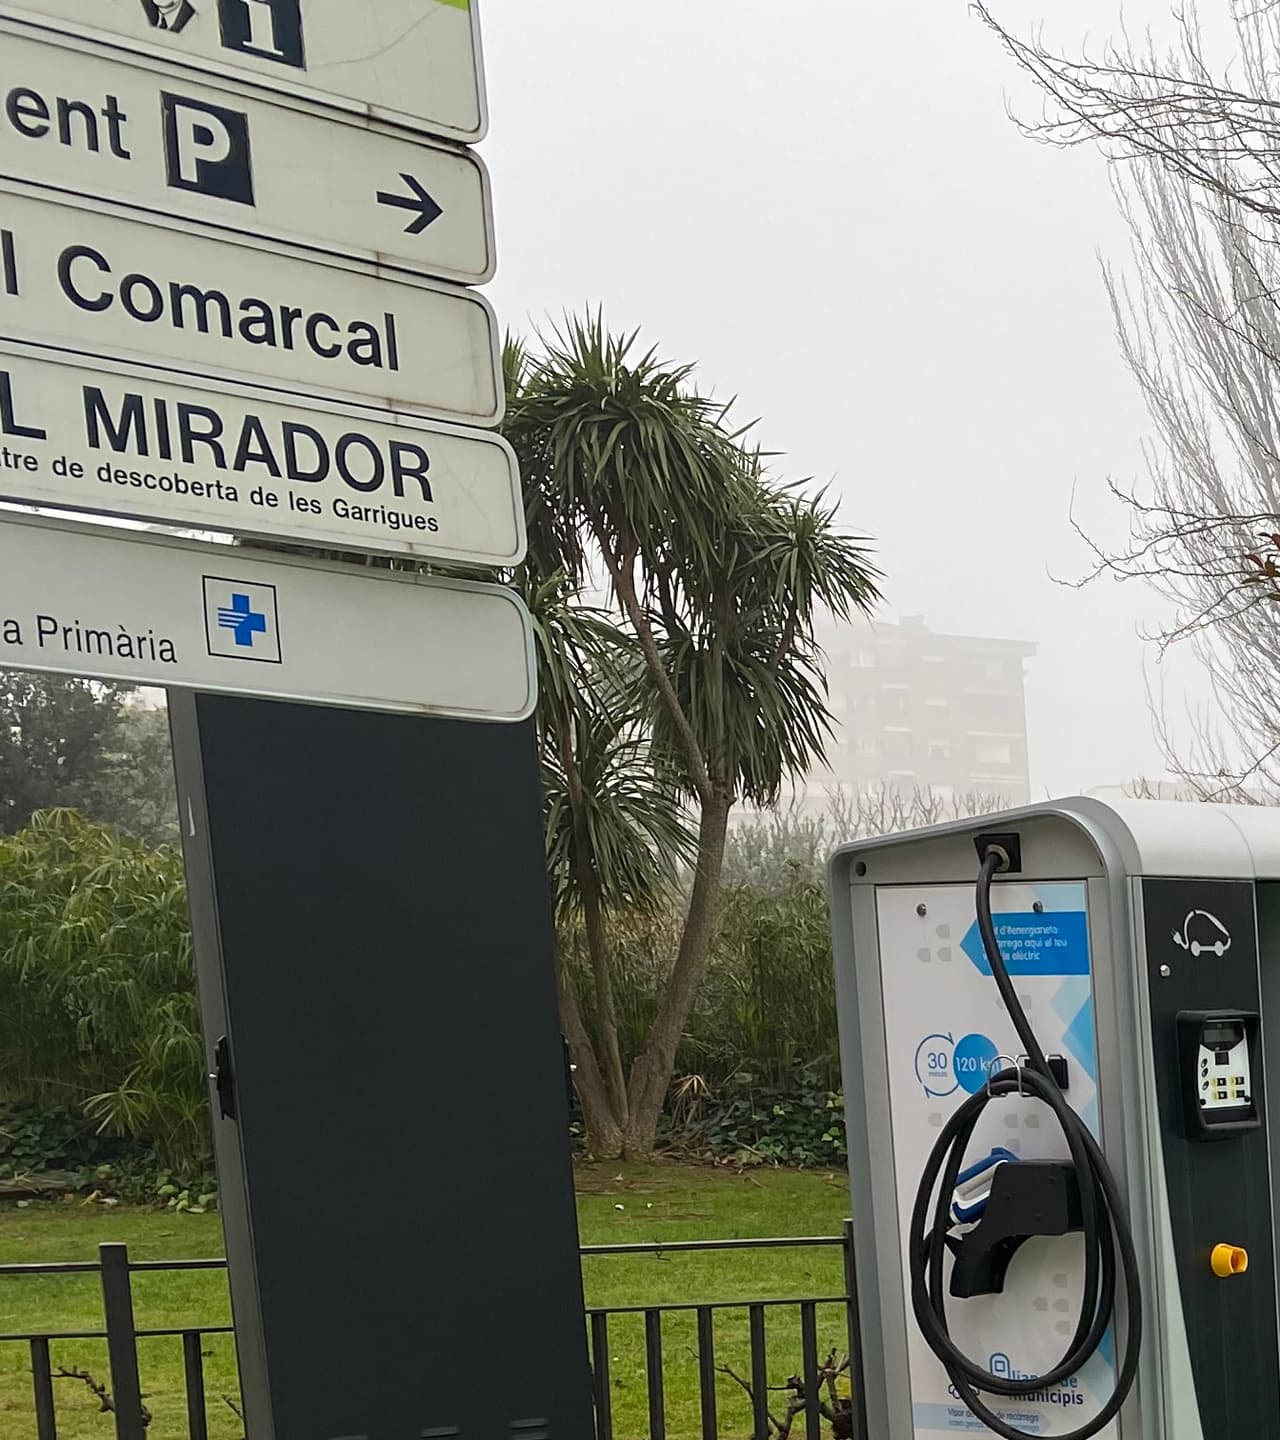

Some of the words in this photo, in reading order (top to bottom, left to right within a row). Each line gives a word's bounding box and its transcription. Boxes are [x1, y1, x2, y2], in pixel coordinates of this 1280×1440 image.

[6, 87, 131, 160] ent
[175, 103, 231, 184] P
[57, 245, 400, 371] Comarcal
[82, 384, 434, 503] MIRADOR
[52, 455, 84, 478] de
[97, 462, 238, 502] descoberta
[250, 484, 279, 508] de
[289, 492, 322, 515] les
[332, 499, 439, 532] Garrigues
[3, 618, 23, 645] a
[37, 615, 177, 663] Primària
[927, 1052, 947, 1070] 30
[956, 1057, 977, 1072] 120
